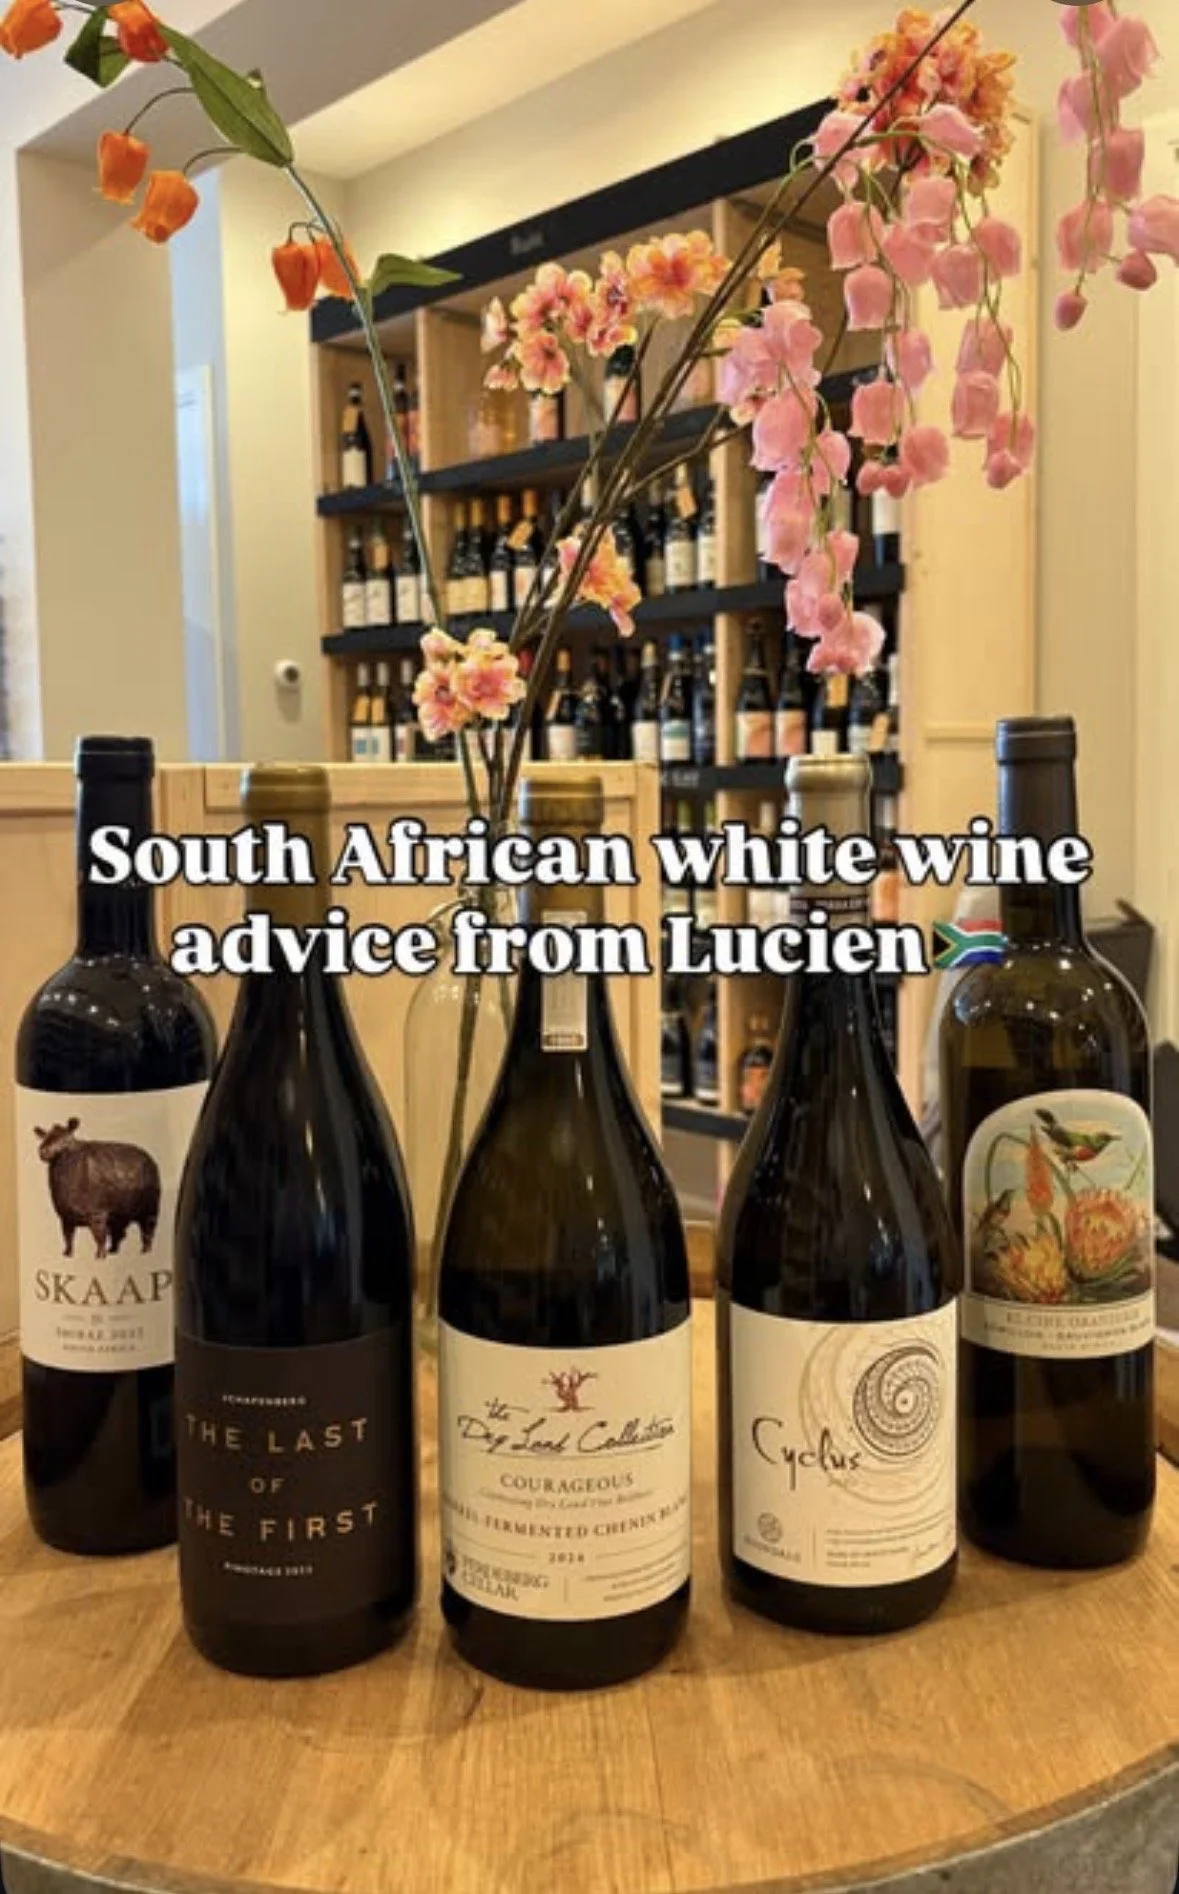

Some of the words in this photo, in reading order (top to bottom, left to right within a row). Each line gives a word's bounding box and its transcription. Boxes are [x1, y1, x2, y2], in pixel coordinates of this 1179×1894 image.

[35, 1268, 173, 1306] SKAAP
[186, 1413, 242, 1450] THE
[267, 1417, 368, 1454] LAST
[751, 1415, 864, 1491] Cyclus
[249, 1477, 285, 1494] OF
[500, 1472, 633, 1494] COURAGEOUS
[184, 1498, 236, 1538] THE
[259, 1501, 378, 1543] FIRST
